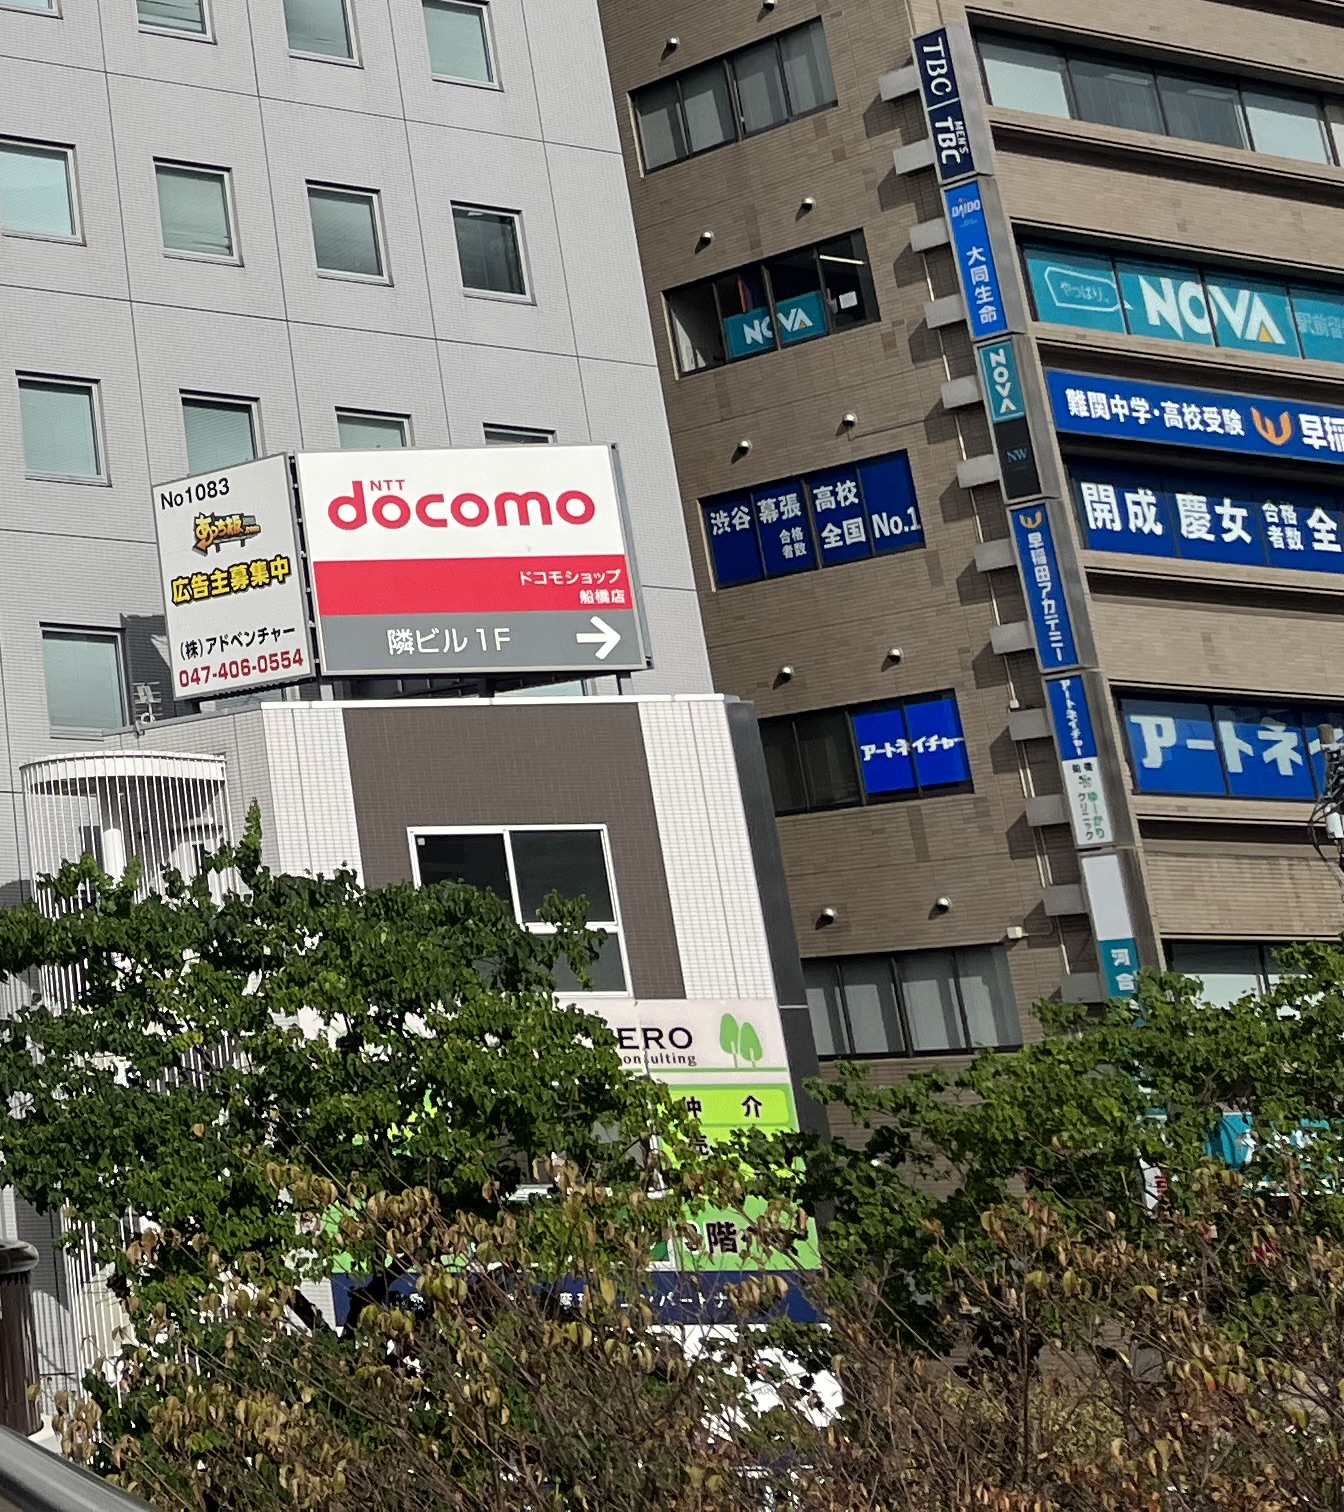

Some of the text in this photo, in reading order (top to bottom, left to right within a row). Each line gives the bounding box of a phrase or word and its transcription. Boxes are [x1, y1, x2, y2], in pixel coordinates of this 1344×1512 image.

[923, 37, 952, 96] TBC
[935, 116, 961, 165] TBC
[966, 246, 998, 325] 大同生命
[1138, 274, 1287, 345] NOVA
[743, 307, 814, 345] NOVA
[989, 348, 1017, 414] NOVA
[161, 478, 231, 510] No1083
[327, 480, 596, 530] docomo
[369, 479, 406, 491] NTT
[171, 554, 292, 606] 広告主募集中
[519, 568, 622, 587] ドコモショップ
[579, 589, 626, 606] 船橋店
[179, 648, 304, 688] 047-406-0554
